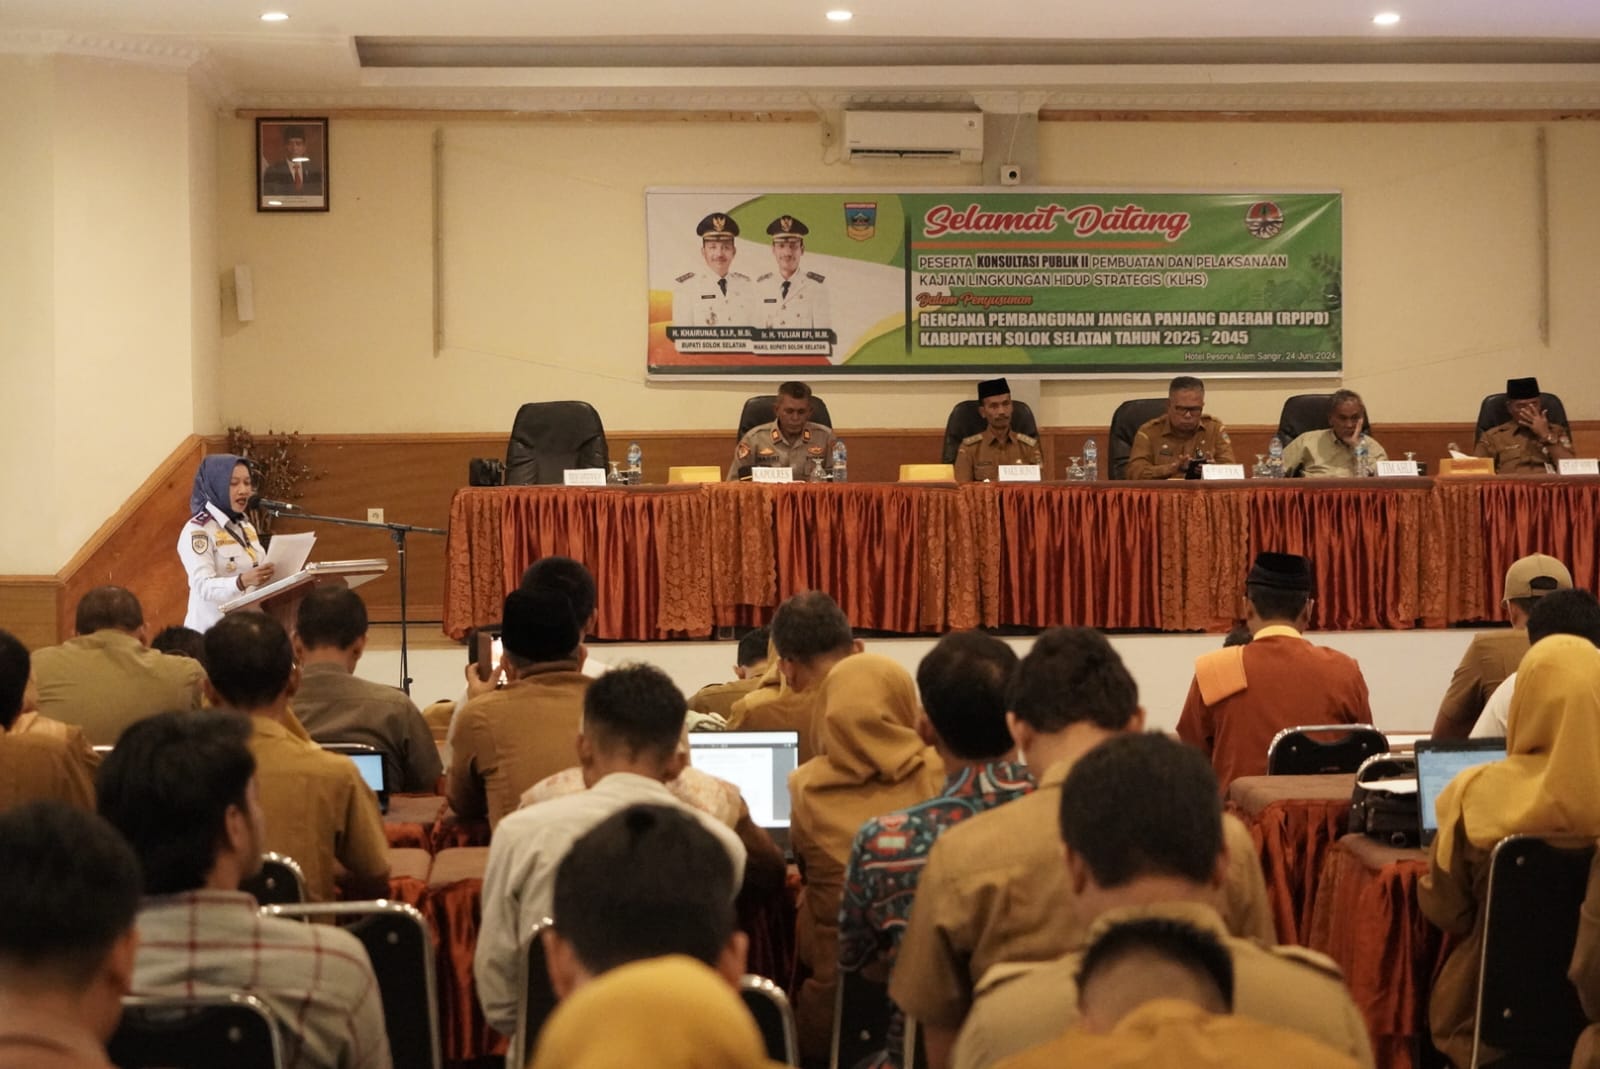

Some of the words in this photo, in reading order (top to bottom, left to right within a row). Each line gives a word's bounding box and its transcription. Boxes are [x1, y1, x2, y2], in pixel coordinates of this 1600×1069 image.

[924, 203, 1065, 237] Selamat
[1067, 203, 1190, 240] Datang
[919, 256, 973, 268] PESERTA
[977, 255, 1039, 268] KONSULTASI
[1042, 255, 1078, 268] PUBLIK
[1081, 255, 1089, 267] II
[1092, 256, 1165, 268] PEMBUATAN
[1168, 256, 1194, 267] DAN
[1197, 256, 1287, 268] PELAKSANAAN
[919, 274, 966, 286] KAJIAN
[969, 274, 1050, 286] LINGKUNGAN
[1054, 274, 1090, 286] HIDUP
[1095, 273, 1162, 286] STRATEGIS
[1165, 273, 1208, 287] (KLHS)
[960, 292, 1032, 308] Penyusunan
[920, 313, 985, 326] RENCANA
[989, 313, 1095, 326] PEMBANGUNAN
[1098, 313, 1152, 326] JANGKA
[1155, 312, 1215, 326] PANJANG
[1219, 312, 1273, 325] DAERAH
[1276, 311, 1329, 326] (RPJPD)
[920, 332, 1001, 346] KABUPATEN
[1005, 332, 1050, 345] SOLOK
[1054, 332, 1111, 345] SELATAN
[1115, 332, 1160, 345] TAHUN
[1164, 331, 1200, 344] 2025
[1212, 331, 1248, 344] 2045
[1184, 352, 1205, 360] Hotel
[1286, 352, 1296, 360] 24
